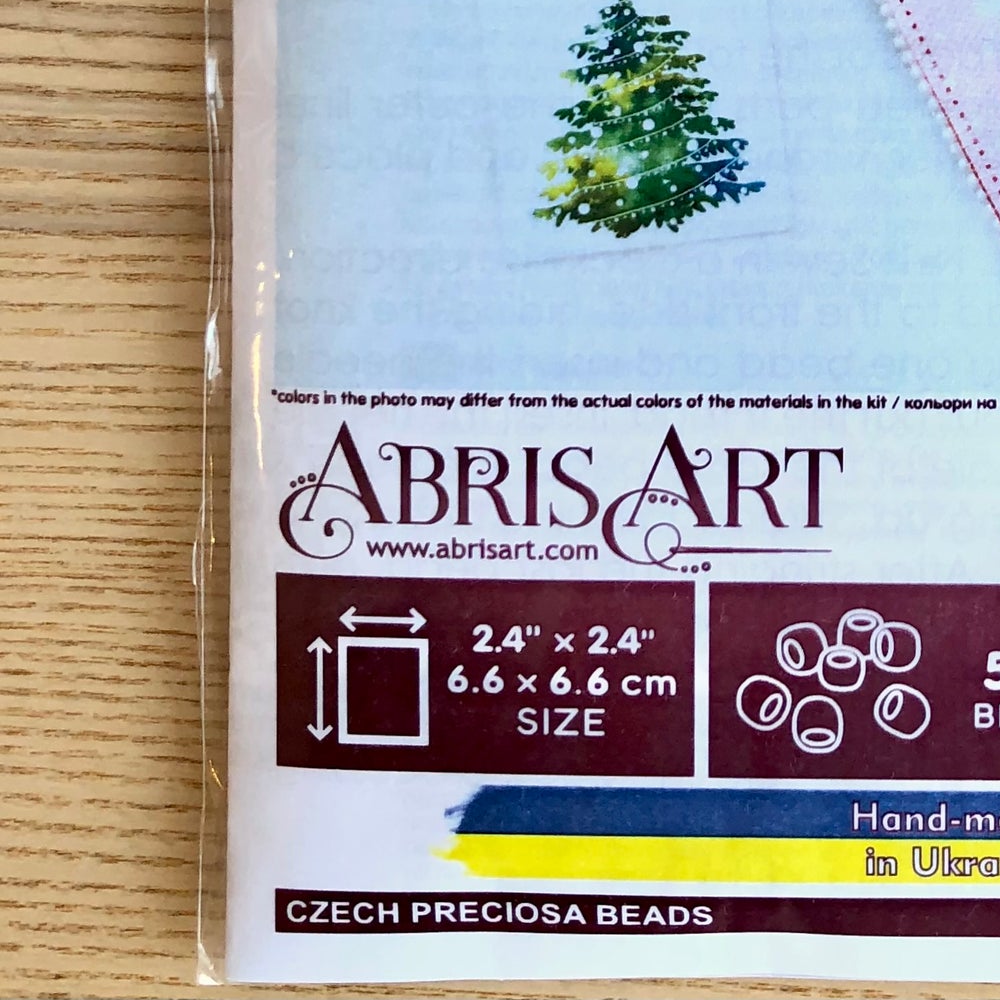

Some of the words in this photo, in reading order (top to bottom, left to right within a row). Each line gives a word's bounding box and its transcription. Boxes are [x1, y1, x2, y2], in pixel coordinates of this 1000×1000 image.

[323, 389, 337, 405] in
[340, 390, 367, 406] the
[370, 391, 418, 410] photo
[420, 395, 456, 411] may
[459, 392, 505, 408] differ
[508, 392, 548, 408] from
[550, 393, 579, 408] the
[582, 393, 632, 409] actual
[635, 393, 683, 409] colors
[686, 393, 704, 409] of
[708, 393, 736, 409] the
[739, 394, 814, 410] materials
[817, 394, 832, 409] in
[835, 394, 863, 410] the
[866, 394, 888, 410] kit
[891, 395, 900, 410] /
[904, 398, 973, 414] кольори
[976, 398, 997, 410] на
[279, 420, 599, 560] ABRIS
[601, 424, 844, 572] ART
[365, 537, 599, 561] www.abrisart.com
[447, 664, 505, 694] 6.6
[549, 666, 609, 696] 6.6
[621, 674, 677, 696] cm
[517, 707, 606, 737] SIZE
[866, 848, 898, 876] in
[286, 900, 400, 924] CZECH
[411, 901, 587, 925] PRECIOSA
[596, 904, 714, 926] BEADS
